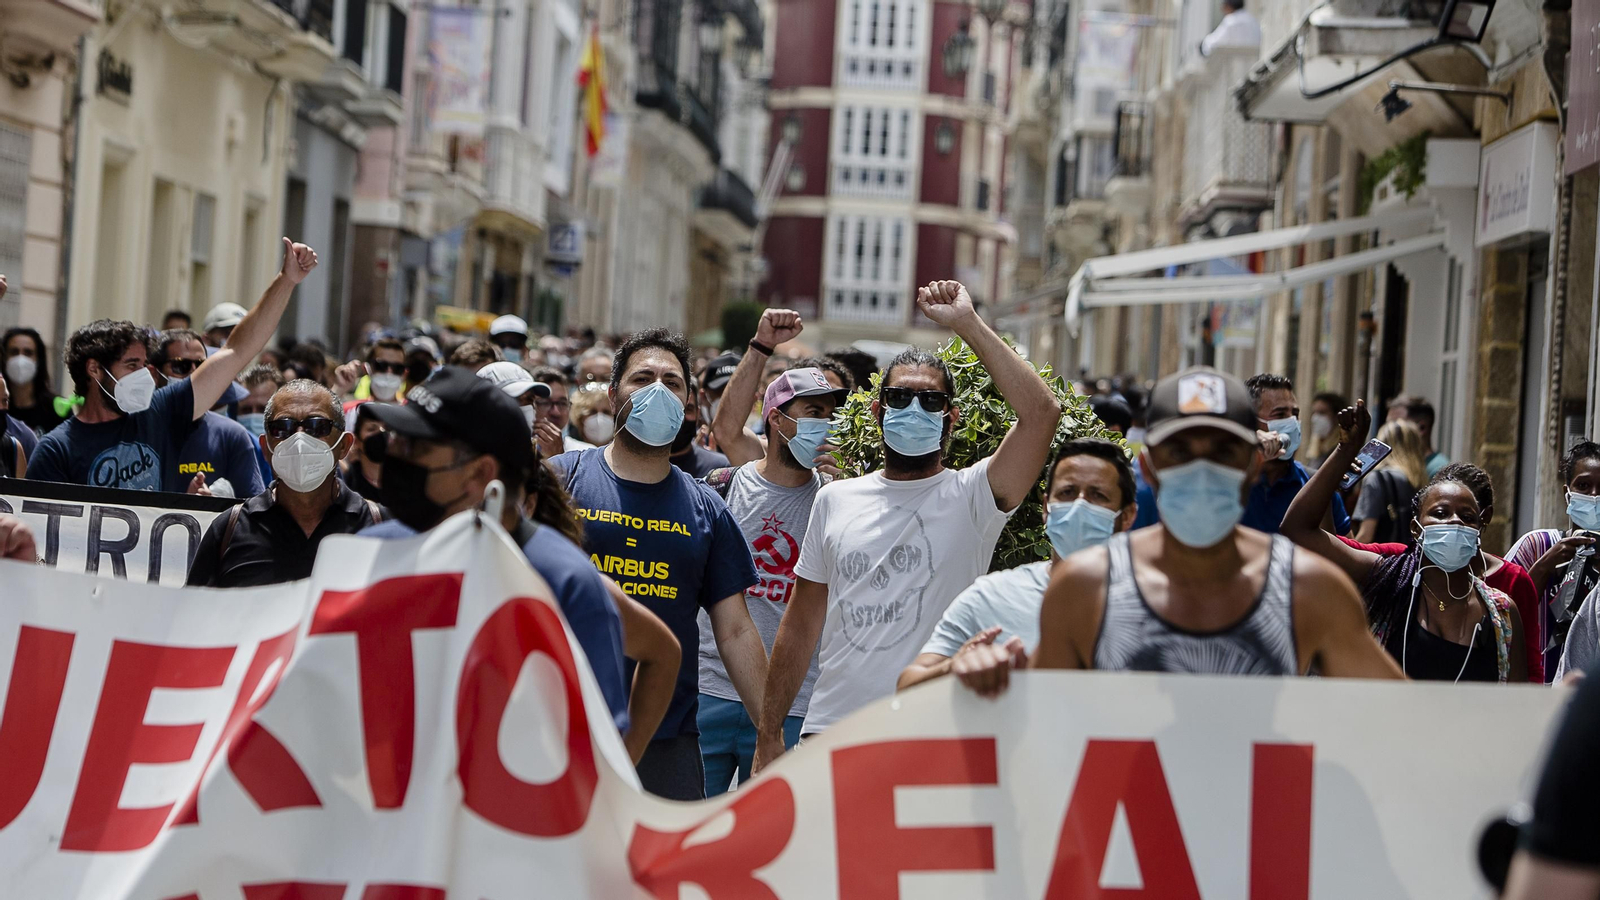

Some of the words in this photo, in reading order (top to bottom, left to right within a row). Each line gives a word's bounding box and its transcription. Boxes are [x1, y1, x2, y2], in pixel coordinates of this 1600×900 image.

[93, 442, 154, 488] Jack
[179, 462, 215, 474] REAL
[574, 508, 644, 530] PUERTO
[647, 519, 691, 537] REAL
[0, 497, 201, 584] TRO
[589, 553, 670, 580] AIRBUS
